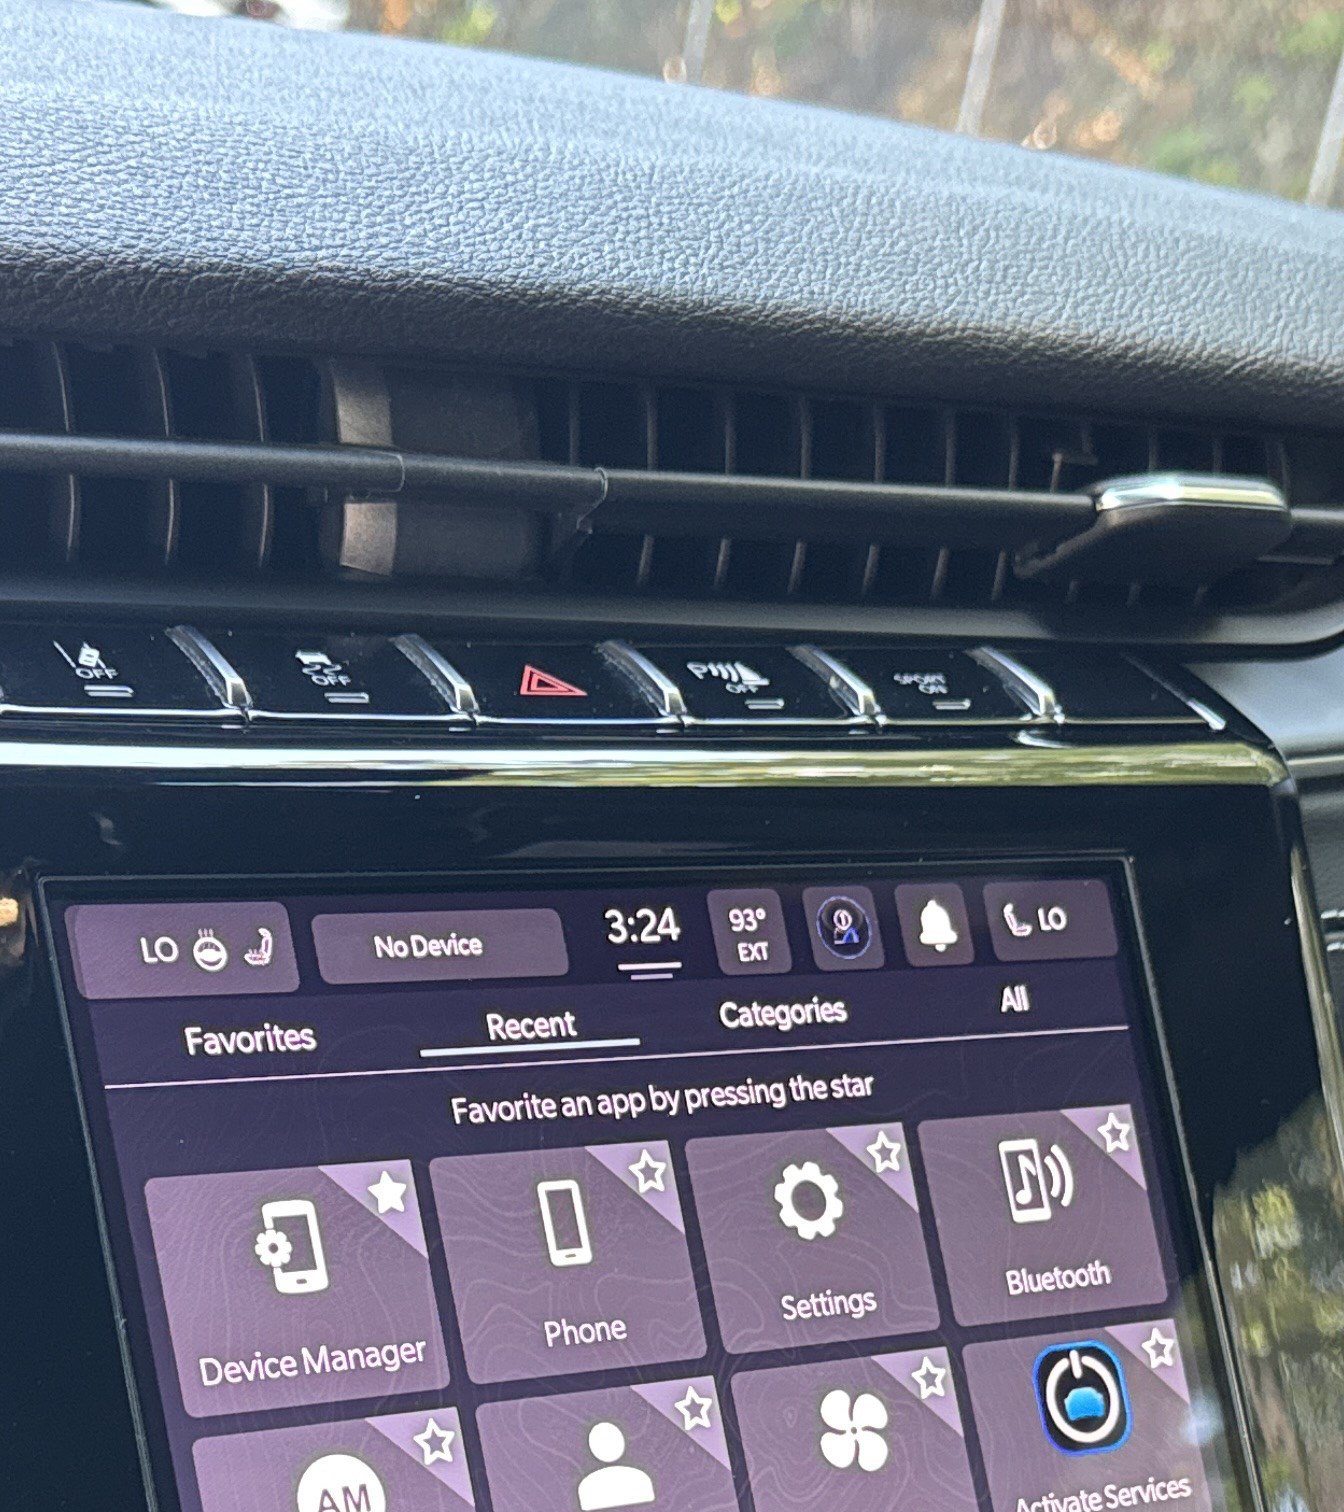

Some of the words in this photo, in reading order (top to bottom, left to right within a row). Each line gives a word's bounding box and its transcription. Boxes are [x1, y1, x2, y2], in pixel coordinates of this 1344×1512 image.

[75, 668, 118, 680] OFF
[312, 676, 352, 686] OFF
[605, 907, 682, 945] 3:24
[1038, 906, 1067, 932] LO
[140, 936, 178, 963] LO
[374, 935, 407, 958] No
[411, 932, 483, 957] Device
[737, 941, 769, 962] EXT
[719, 996, 848, 1030] Categories
[1000, 985, 1030, 1012] All
[184, 1023, 317, 1056] Favorites
[486, 1011, 577, 1041] Recent
[450, 1090, 556, 1125] Favorite
[561, 1094, 594, 1118] an
[596, 1091, 646, 1123] app
[648, 1083, 680, 1115] by
[685, 1078, 786, 1113] pressing
[789, 1076, 828, 1102] the
[830, 1073, 875, 1098] star
[1006, 1260, 1112, 1296] Bluetooth
[780, 1288, 878, 1322] Settings
[543, 1317, 628, 1348] Phone
[199, 1352, 299, 1388] Device
[301, 1340, 427, 1380] Manager
[1104, 1475, 1193, 1510] Services
